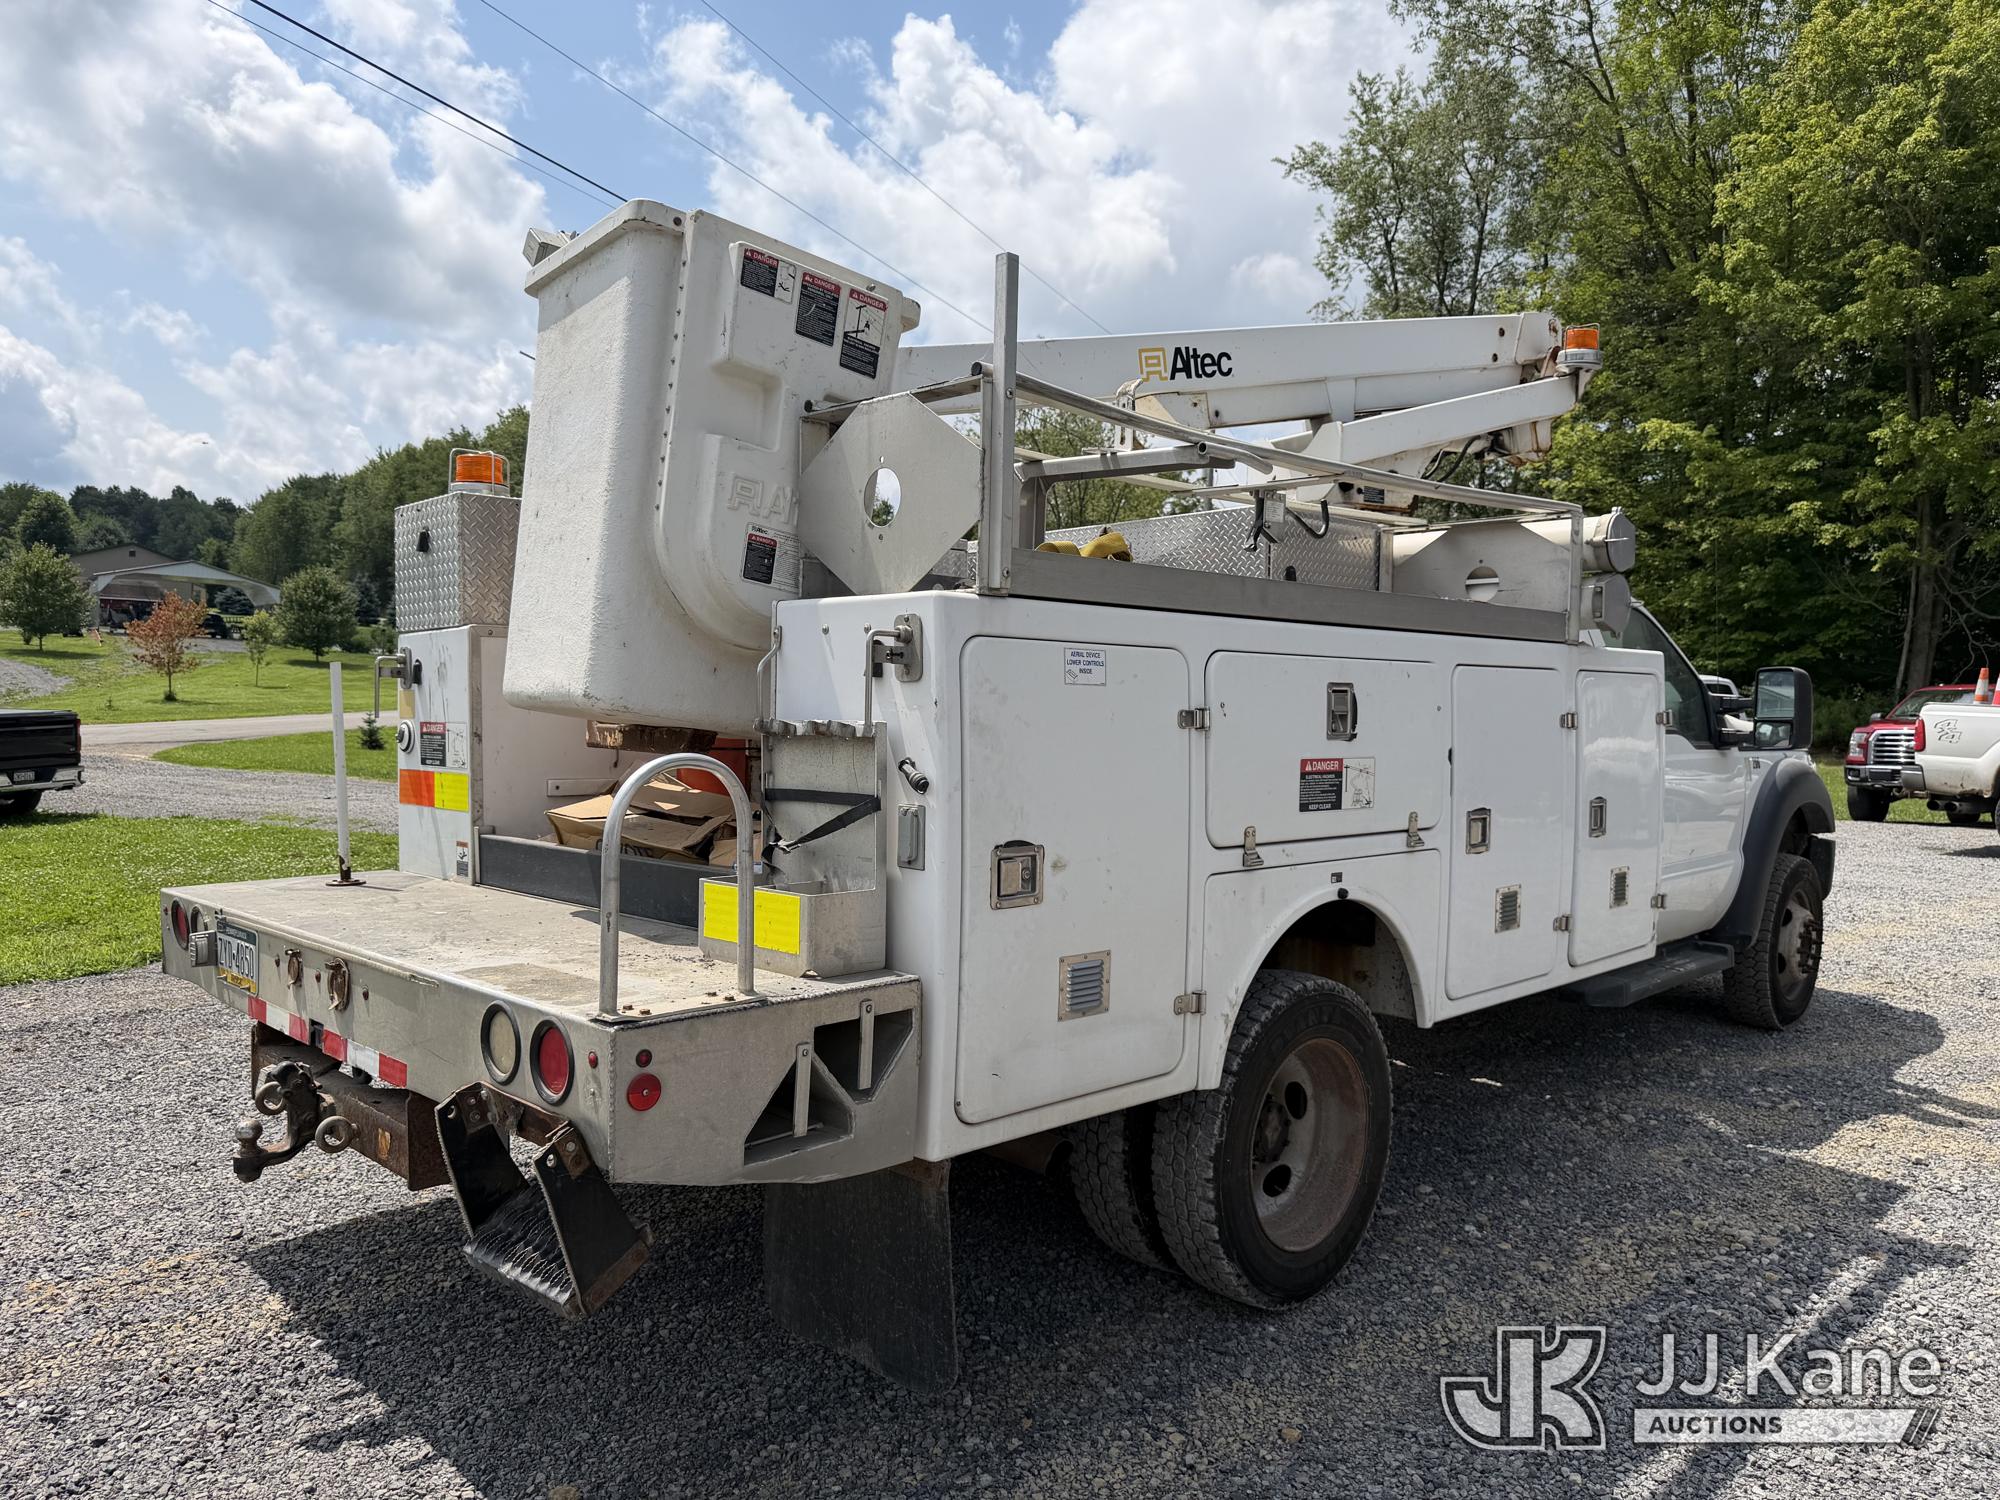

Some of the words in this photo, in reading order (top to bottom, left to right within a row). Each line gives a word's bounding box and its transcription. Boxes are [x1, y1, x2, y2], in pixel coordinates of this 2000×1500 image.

[753, 252, 777, 267] DANGER
[813, 277, 836, 290] DANGER
[860, 294, 884, 309] DANGER
[1169, 346, 1233, 380] Altec
[1312, 760, 1339, 771] DANGER
